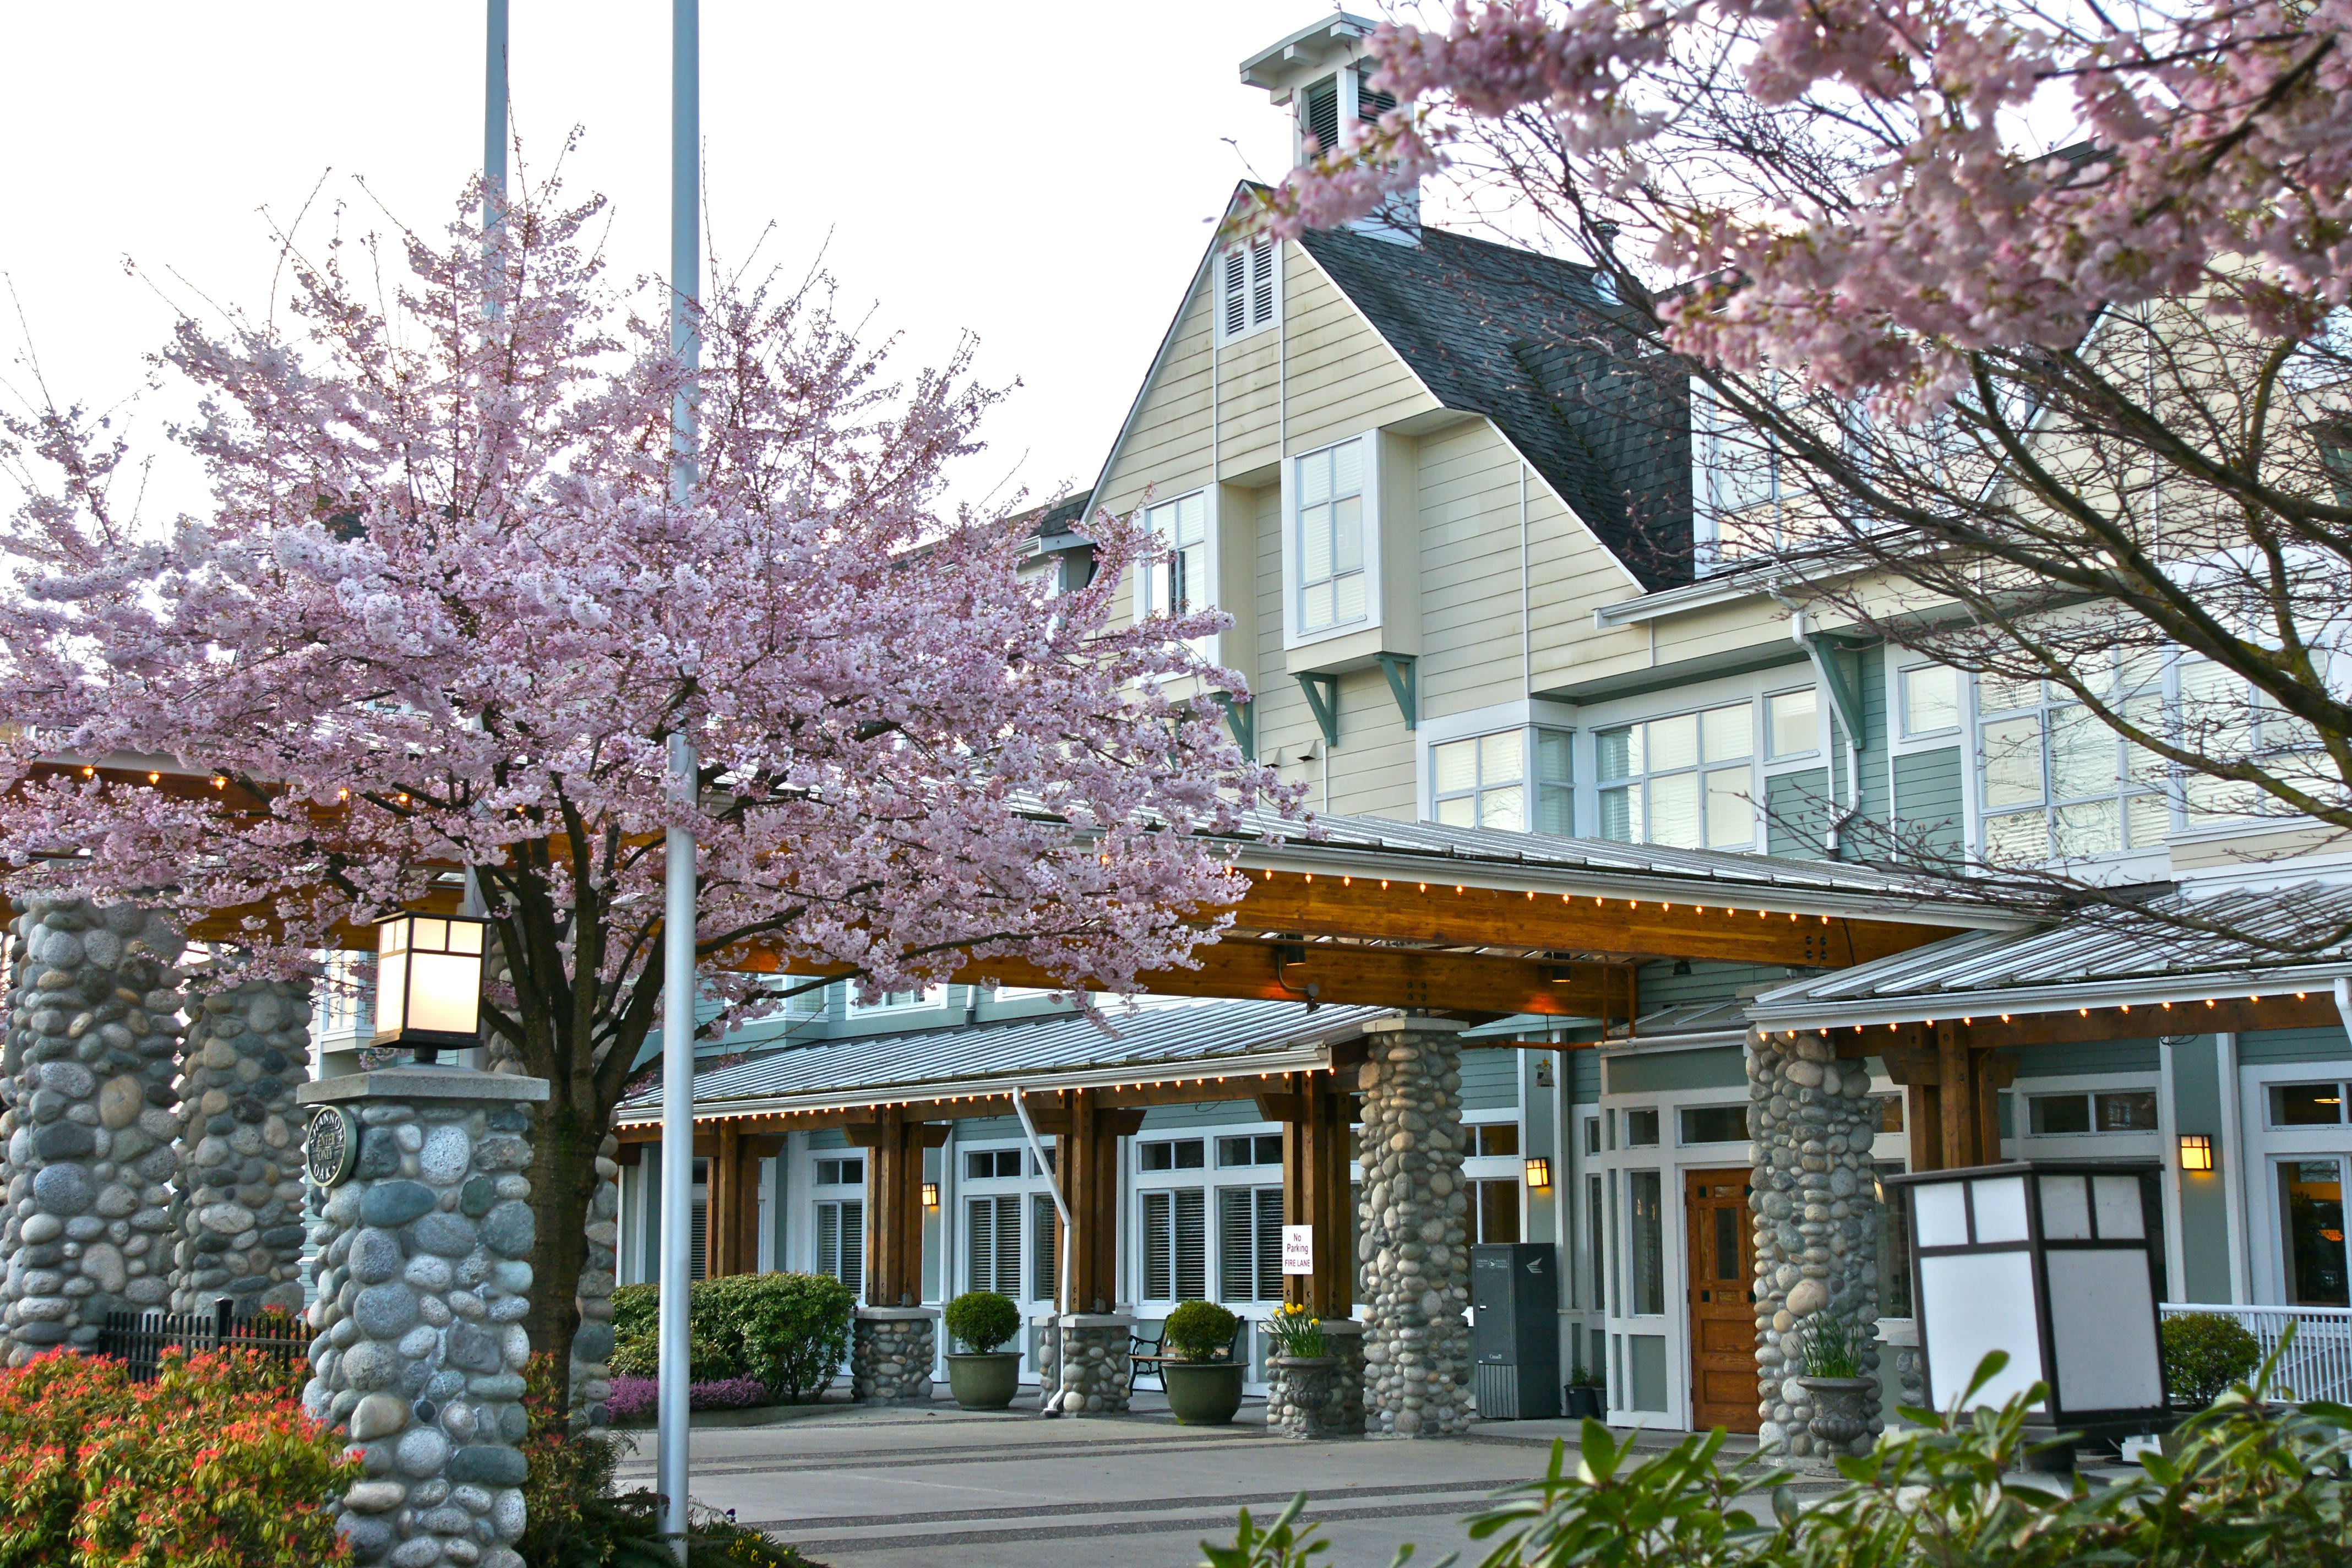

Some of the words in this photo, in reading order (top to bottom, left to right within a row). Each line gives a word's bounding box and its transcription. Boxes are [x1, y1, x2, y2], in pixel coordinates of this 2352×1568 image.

[310, 1111, 344, 1147] SHANNON
[318, 1133, 335, 1146] ENTER
[318, 1148, 333, 1161] ONLY
[314, 1163, 336, 1180] OAKS
[1293, 1233, 1302, 1242] No
[1287, 1243, 1308, 1255] Parking
